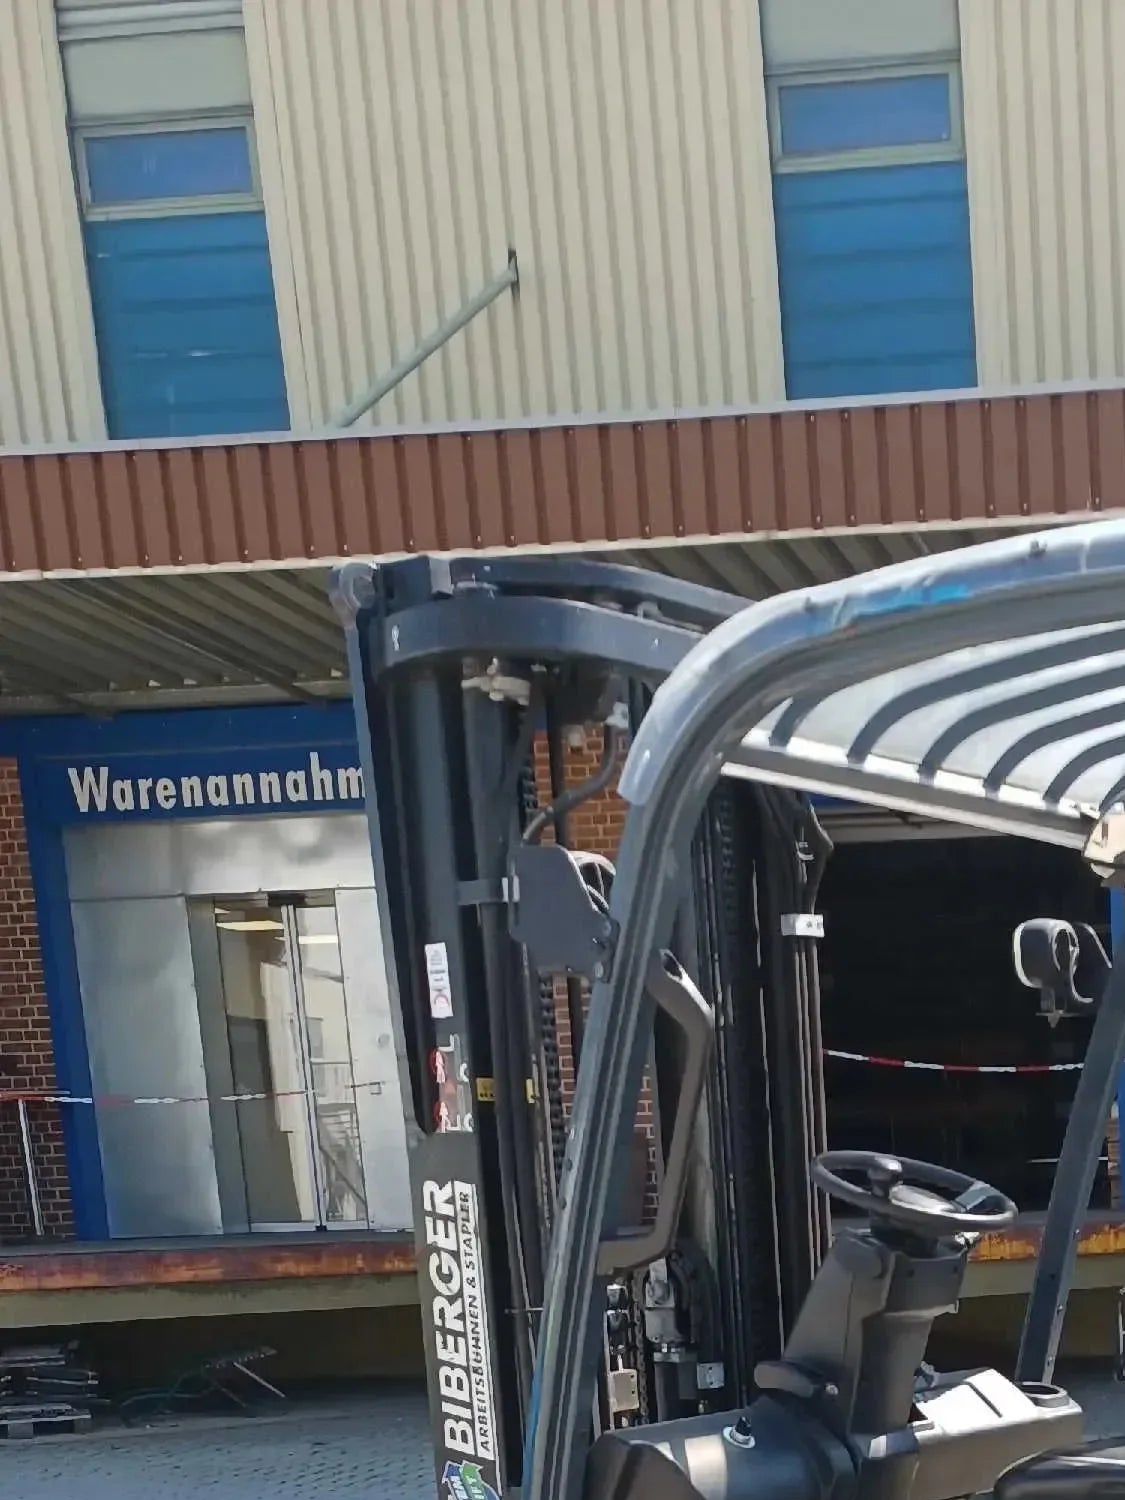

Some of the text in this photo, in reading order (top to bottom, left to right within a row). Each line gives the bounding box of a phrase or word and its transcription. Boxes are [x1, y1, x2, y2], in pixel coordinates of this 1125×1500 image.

[459, 1191, 476, 1270] STAPLER
[423, 1180, 475, 1457] BIBERGER
[466, 1275, 477, 1288] &
